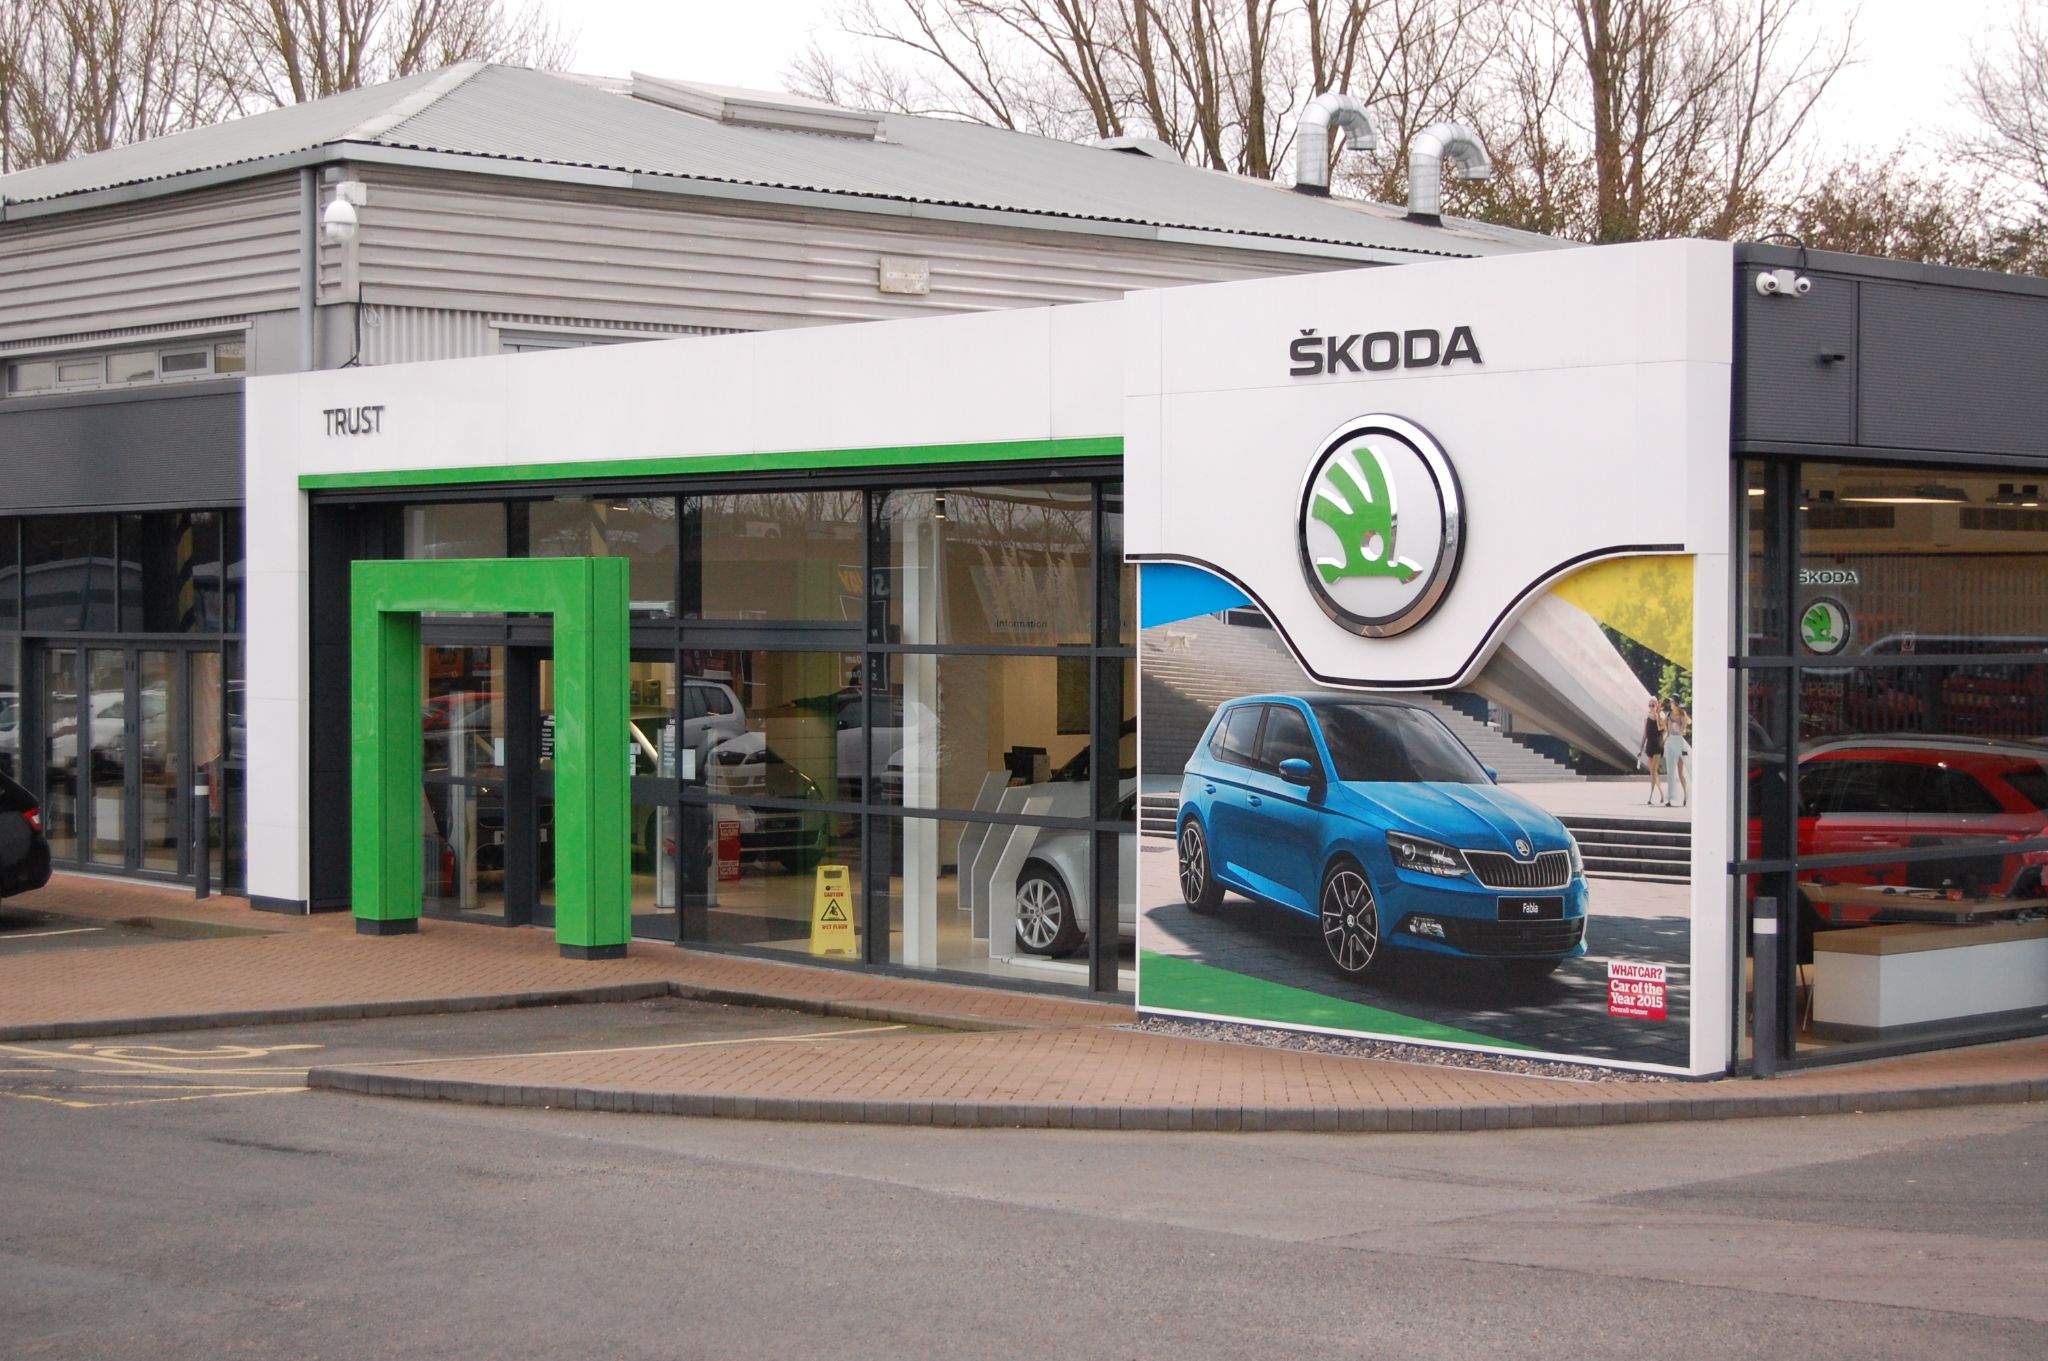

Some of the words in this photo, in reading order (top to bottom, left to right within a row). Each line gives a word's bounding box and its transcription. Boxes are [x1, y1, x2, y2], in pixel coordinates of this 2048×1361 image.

[1289, 325, 1483, 376] ŠKODA
[323, 405, 385, 436] TRUST
[1522, 902, 1539, 914] Fabia
[1638, 966, 1662, 979] CAR?
[1610, 979, 1630, 993] Car
[1630, 982, 1643, 994] of
[1644, 983, 1663, 995] the
[1610, 991, 1636, 1006] Year
[1637, 995, 1663, 1008] 2015
